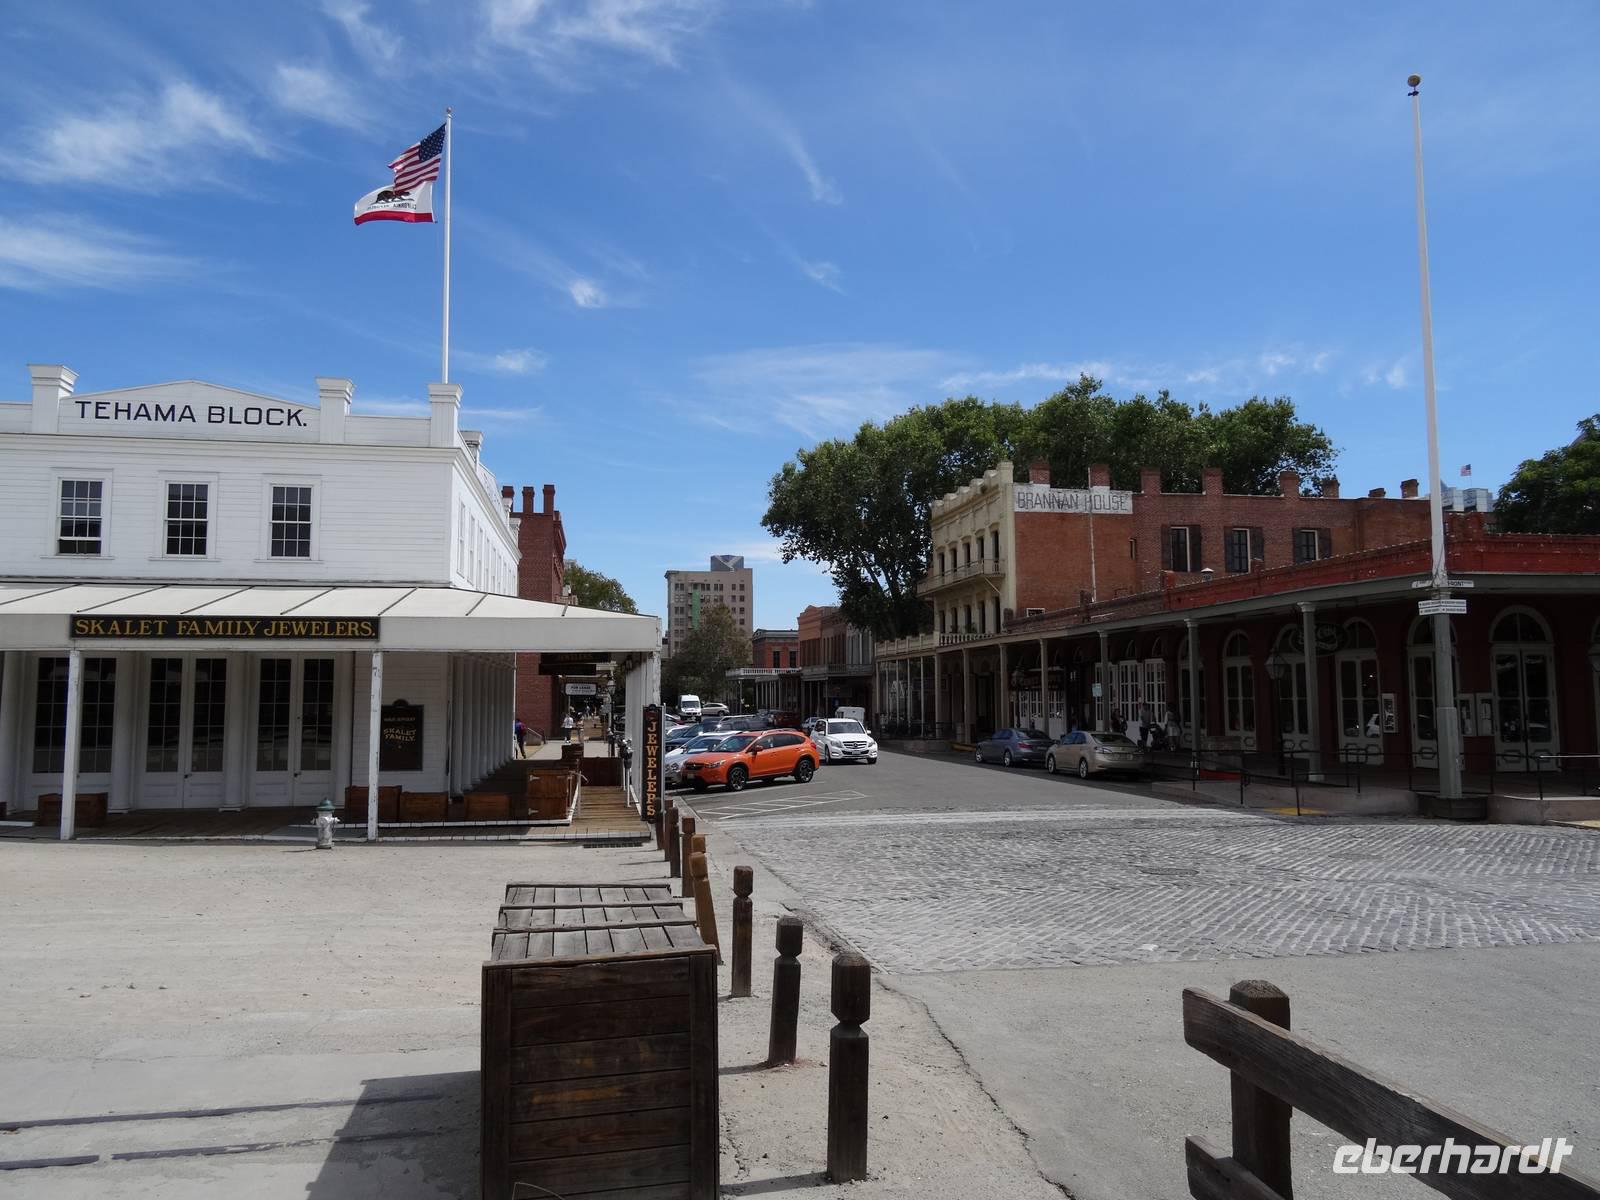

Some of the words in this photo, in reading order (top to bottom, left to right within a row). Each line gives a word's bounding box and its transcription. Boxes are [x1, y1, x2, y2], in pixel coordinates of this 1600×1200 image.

[75, 401, 196, 422] TEHAMA
[207, 405, 307, 427] BLOCK.
[1017, 491, 1079, 510] BRANNAN
[1084, 494, 1129, 511] HOUSE
[75, 619, 168, 635] SKALET
[175, 620, 261, 636] FAMILY
[263, 620, 376, 637] JEWELERS.
[383, 728, 416, 736] SKALET
[646, 721, 659, 816] JEWELERS
